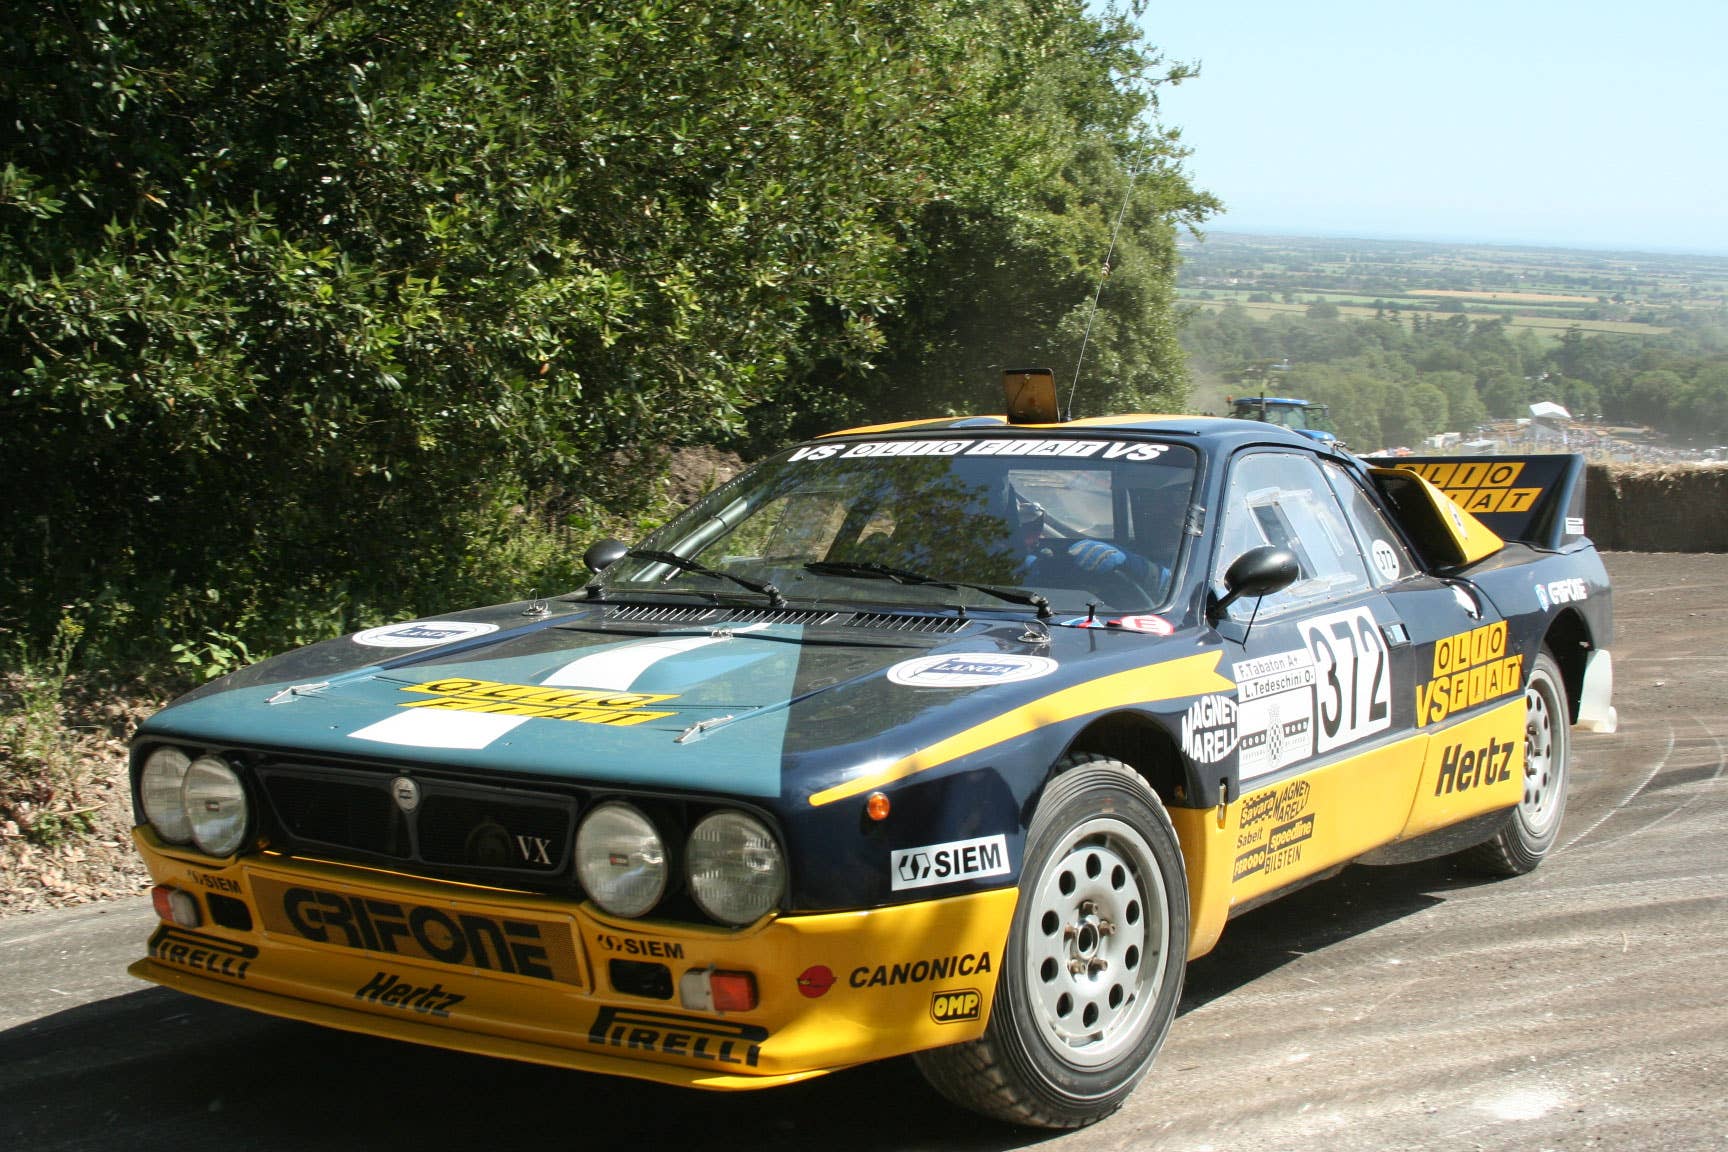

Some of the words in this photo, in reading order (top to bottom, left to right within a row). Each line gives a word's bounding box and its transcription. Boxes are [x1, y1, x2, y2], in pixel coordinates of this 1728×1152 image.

[788, 444, 847, 462] VS
[845, 442, 968, 457] OLIO
[971, 441, 1105, 456] FIAT
[1102, 442, 1169, 460] VS
[1376, 550, 1397, 570] 372
[1436, 624, 1504, 673] OLIO
[418, 680, 664, 708] OLIO
[1309, 615, 1388, 738] 372
[1434, 737, 1515, 797] Hertz
[517, 835, 552, 865] VX
[934, 843, 1002, 878] SIEM
[203, 874, 242, 895] SIEM
[147, 924, 260, 980] PIRELLI
[283, 887, 555, 980] GRIFONE
[624, 938, 685, 959] SIEM
[849, 951, 992, 988] CANONICA
[355, 971, 466, 1018] Hertz
[588, 1005, 770, 1068] PIRELLI
